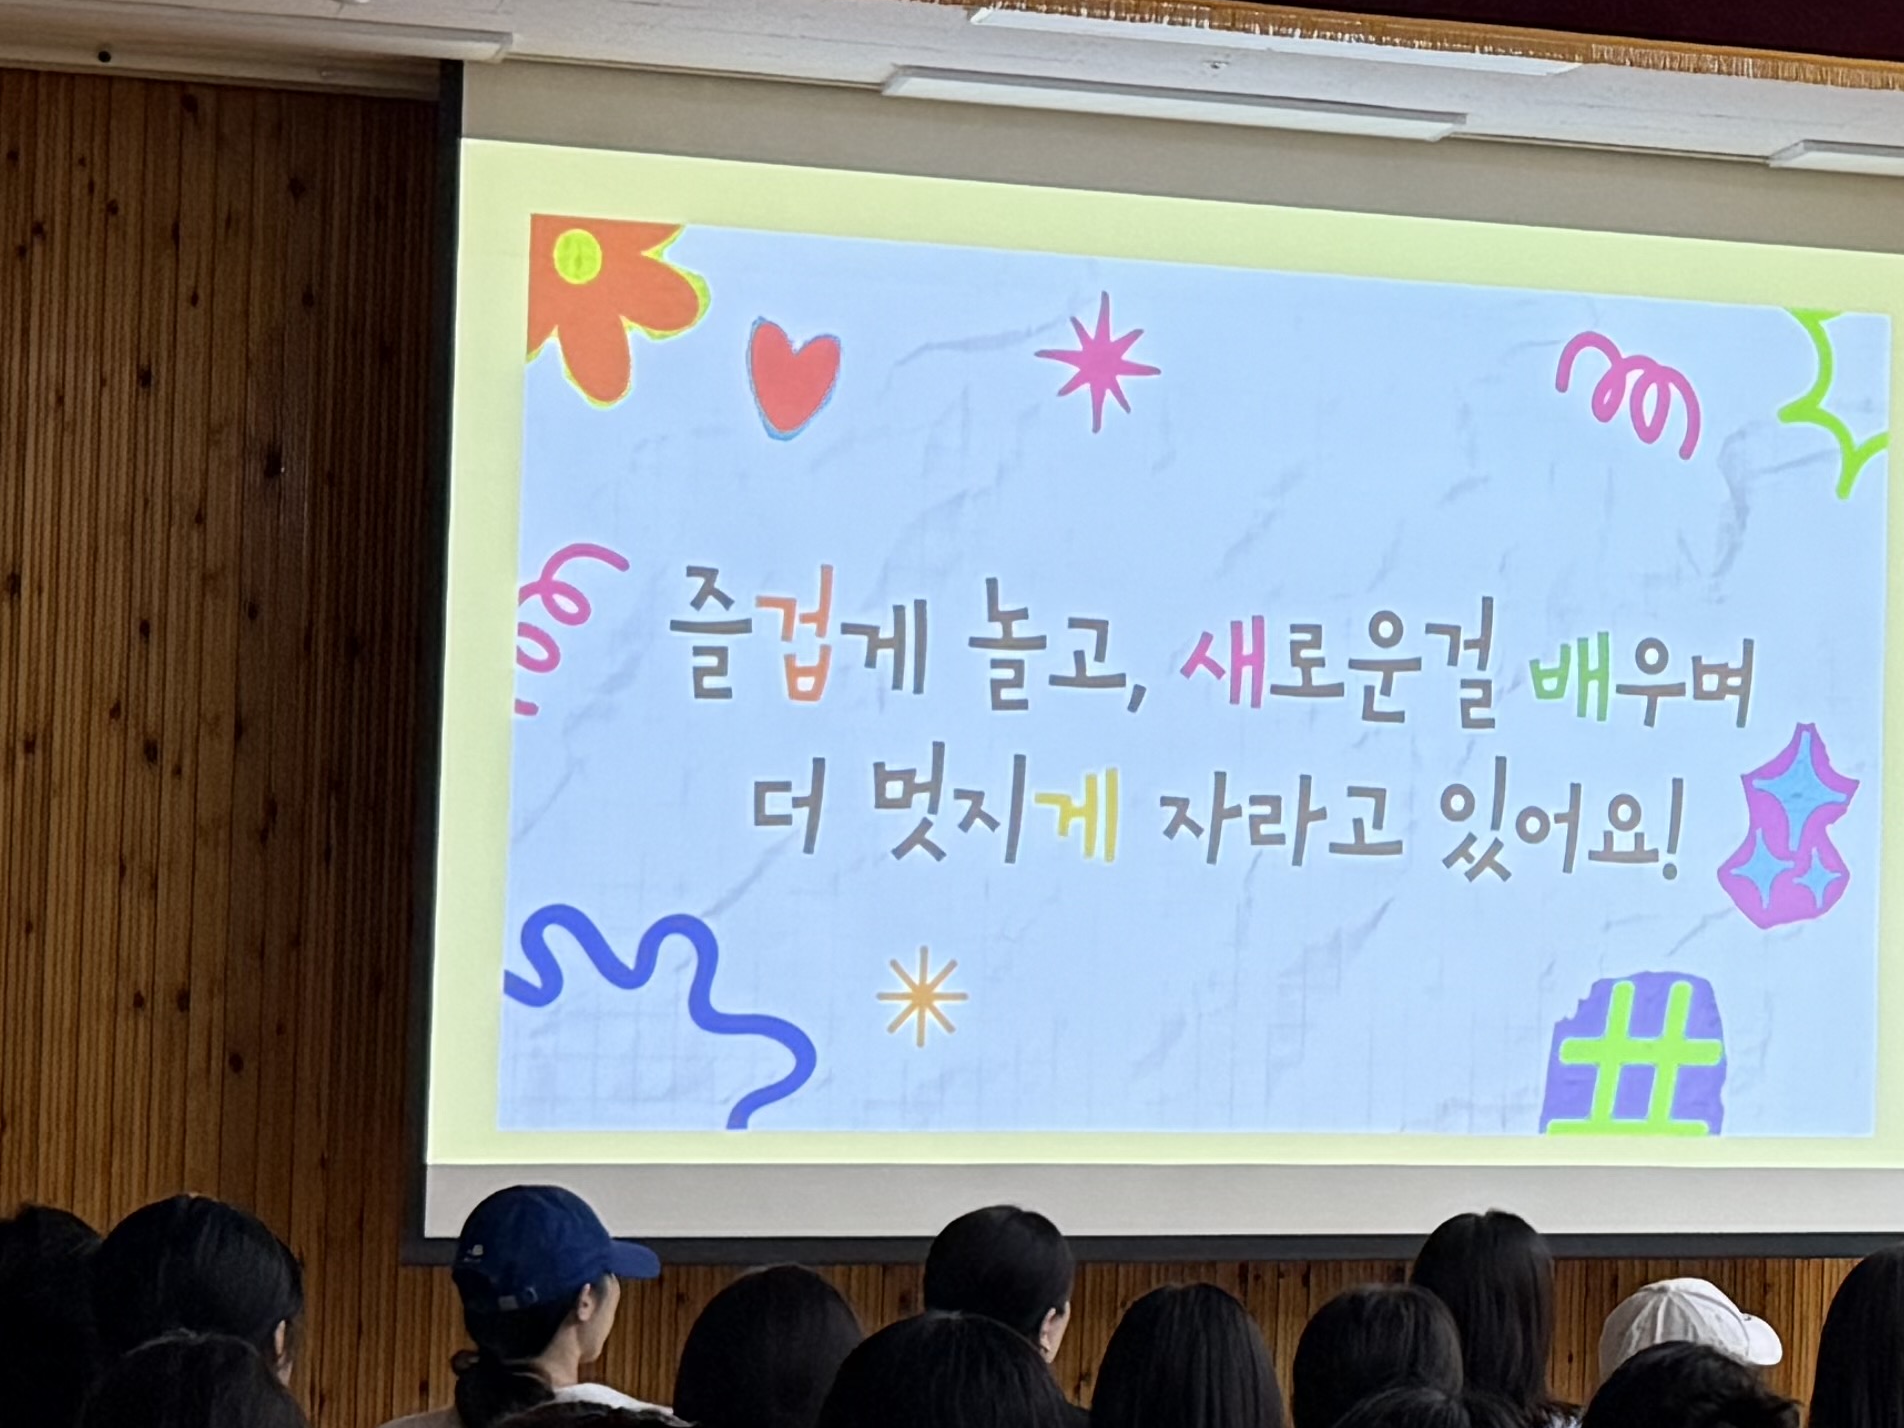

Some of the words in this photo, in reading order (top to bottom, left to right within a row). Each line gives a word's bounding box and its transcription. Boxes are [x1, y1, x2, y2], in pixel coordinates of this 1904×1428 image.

[670, 564, 927, 701] 즐겁게
[968, 577, 1146, 713] 놀고,
[1180, 596, 1496, 729] 새로운걸
[1529, 631, 1754, 728] 배우며
[754, 757, 825, 854] 더
[873, 741, 1118, 864] 멋지게
[1160, 771, 1403, 866] 자라고
[1441, 756, 1684, 882] 있어요!
